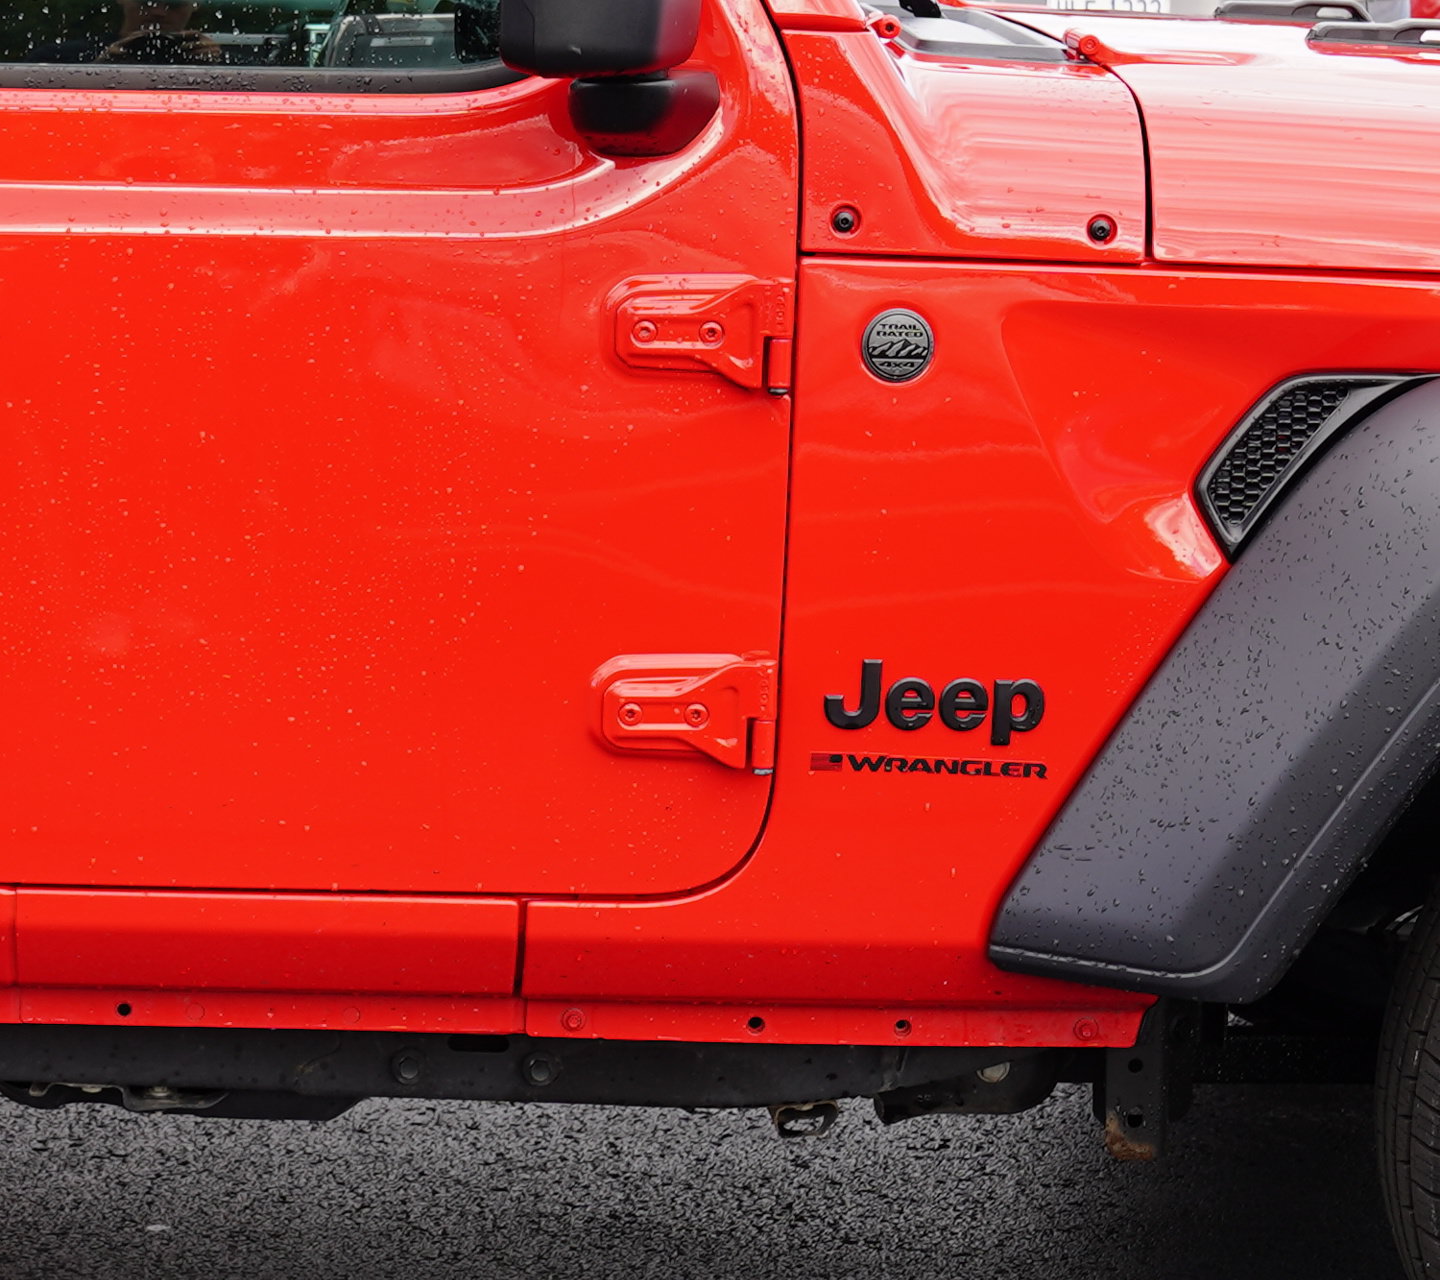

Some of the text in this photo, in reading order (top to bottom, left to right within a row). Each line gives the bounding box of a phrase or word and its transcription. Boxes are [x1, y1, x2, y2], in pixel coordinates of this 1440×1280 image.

[879, 323, 921, 331] TRAIL
[823, 658, 1045, 746] Jeep
[847, 753, 1048, 780] WRANGLER
